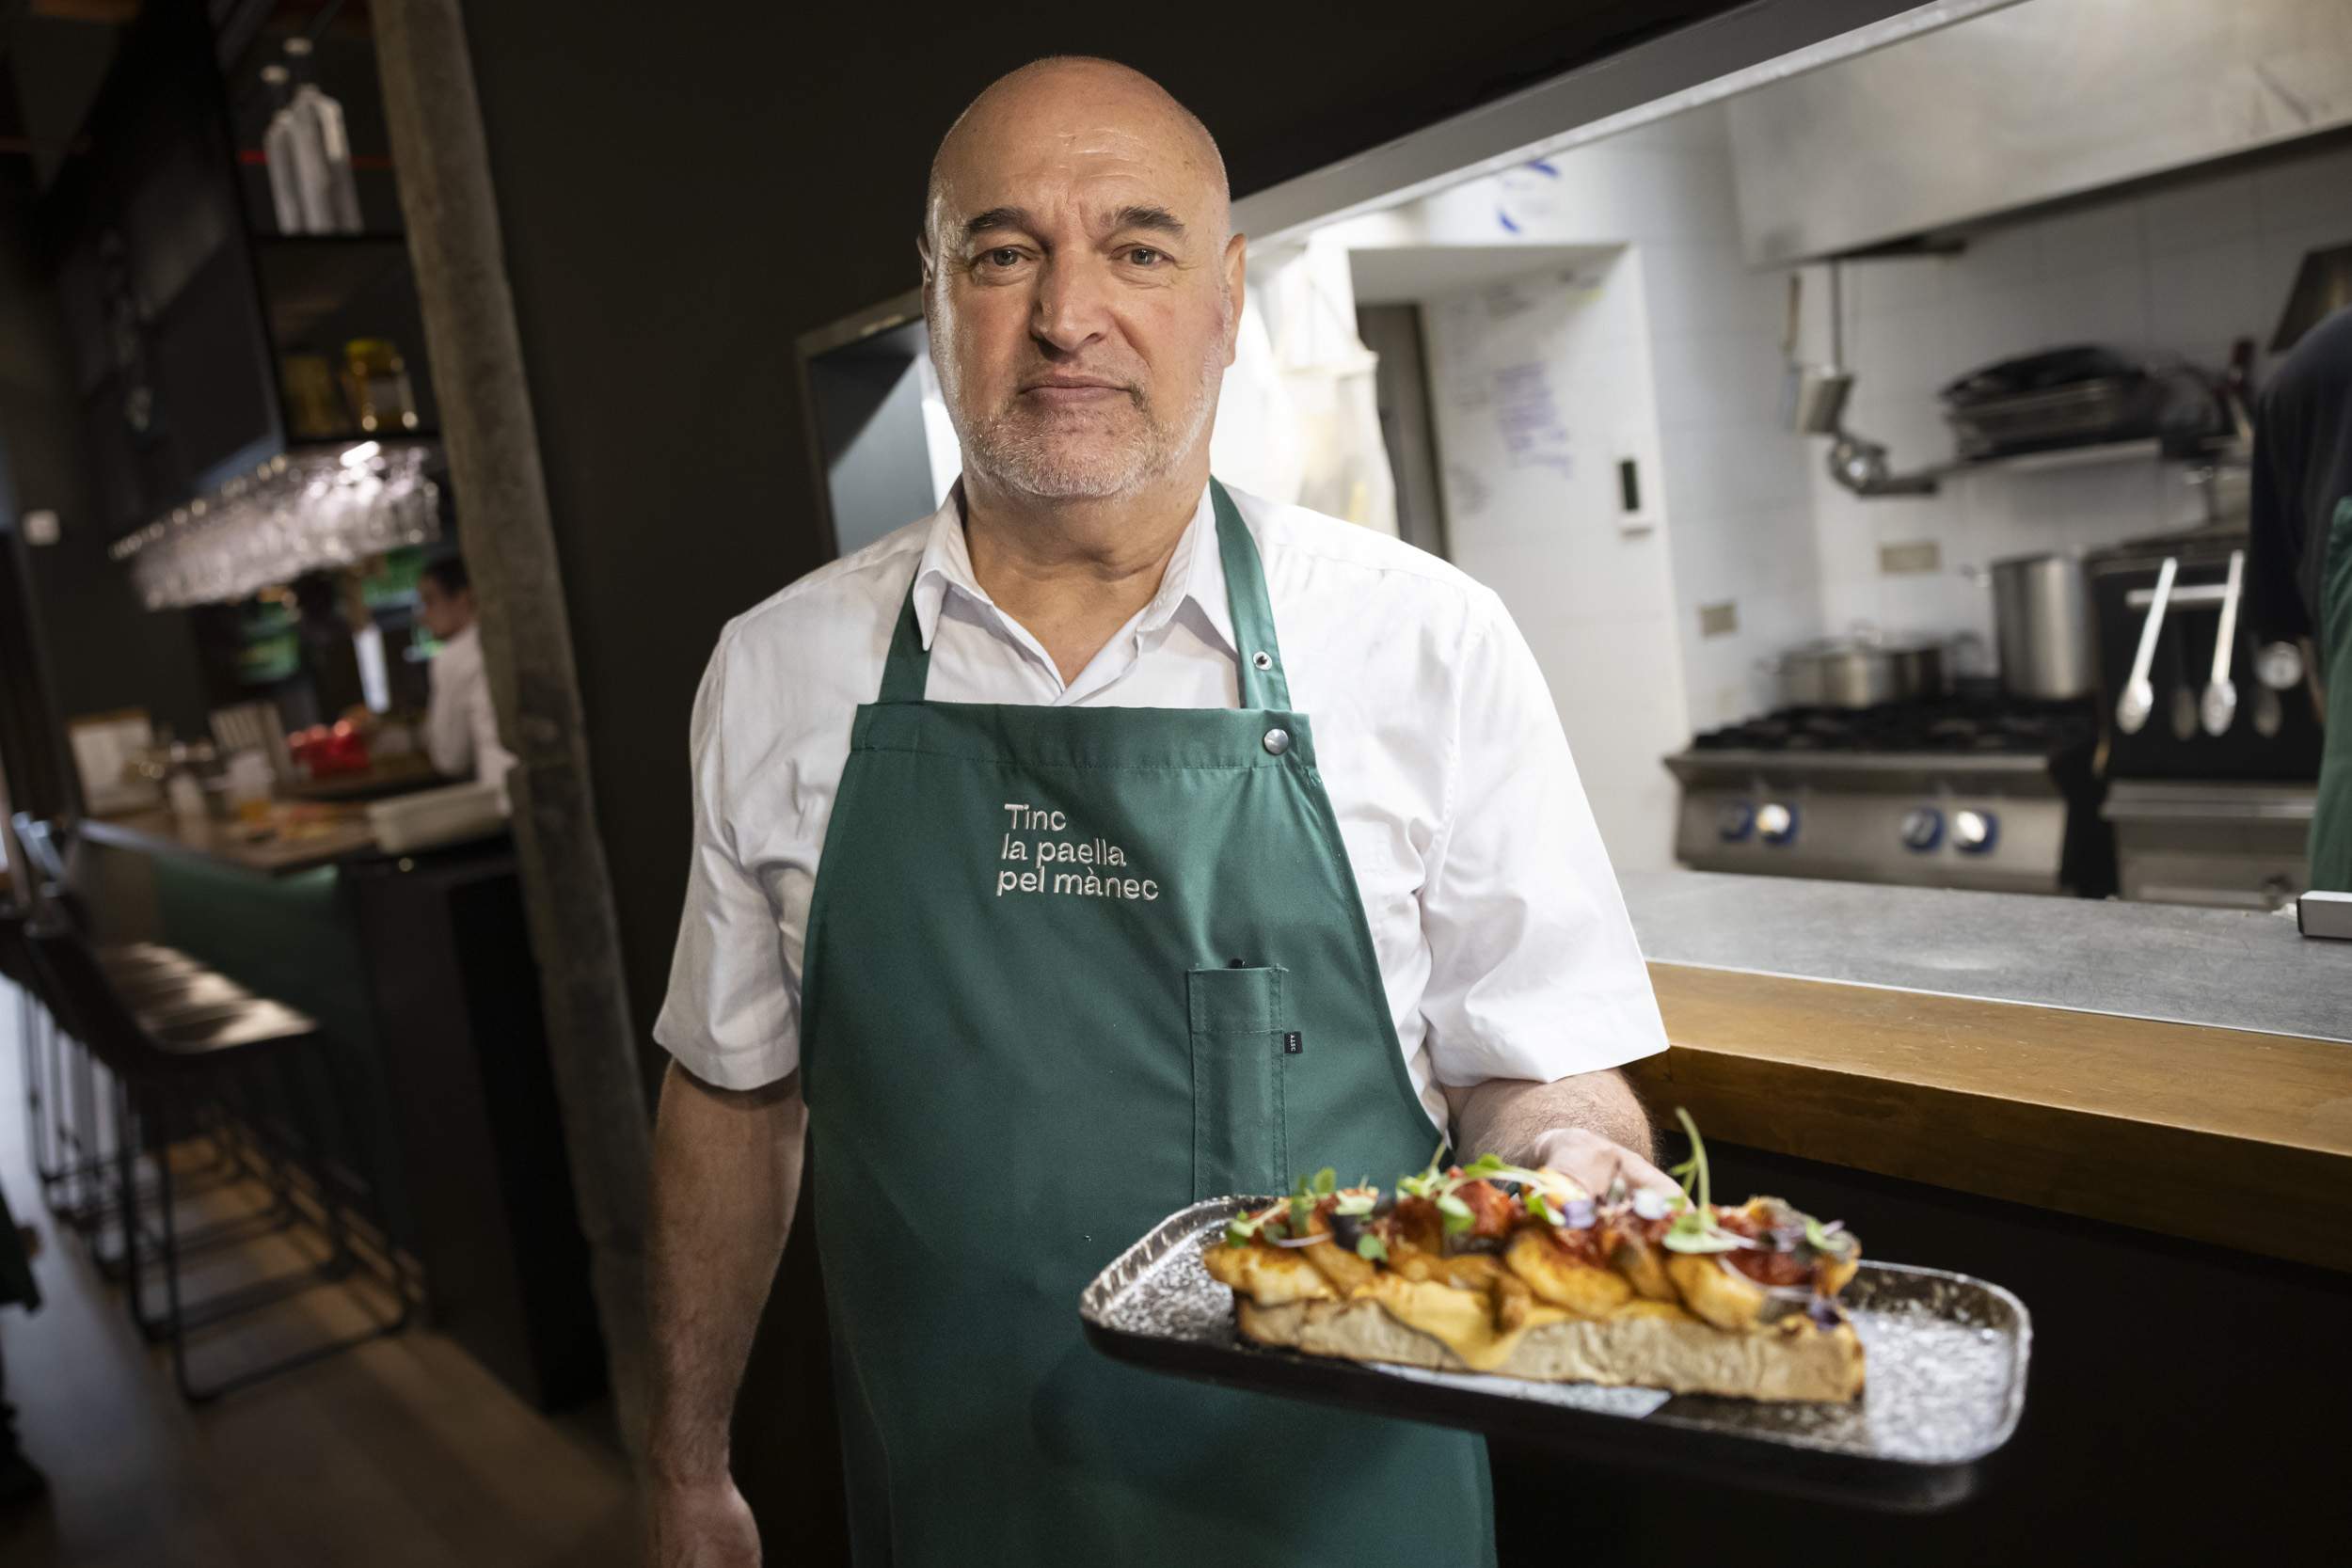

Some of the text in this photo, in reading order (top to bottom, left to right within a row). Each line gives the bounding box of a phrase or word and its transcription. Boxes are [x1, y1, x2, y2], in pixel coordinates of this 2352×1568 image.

[1004, 803, 1067, 832] Tinc
[1001, 832, 1127, 868] la paella
[996, 865, 1160, 901] pel mànec
